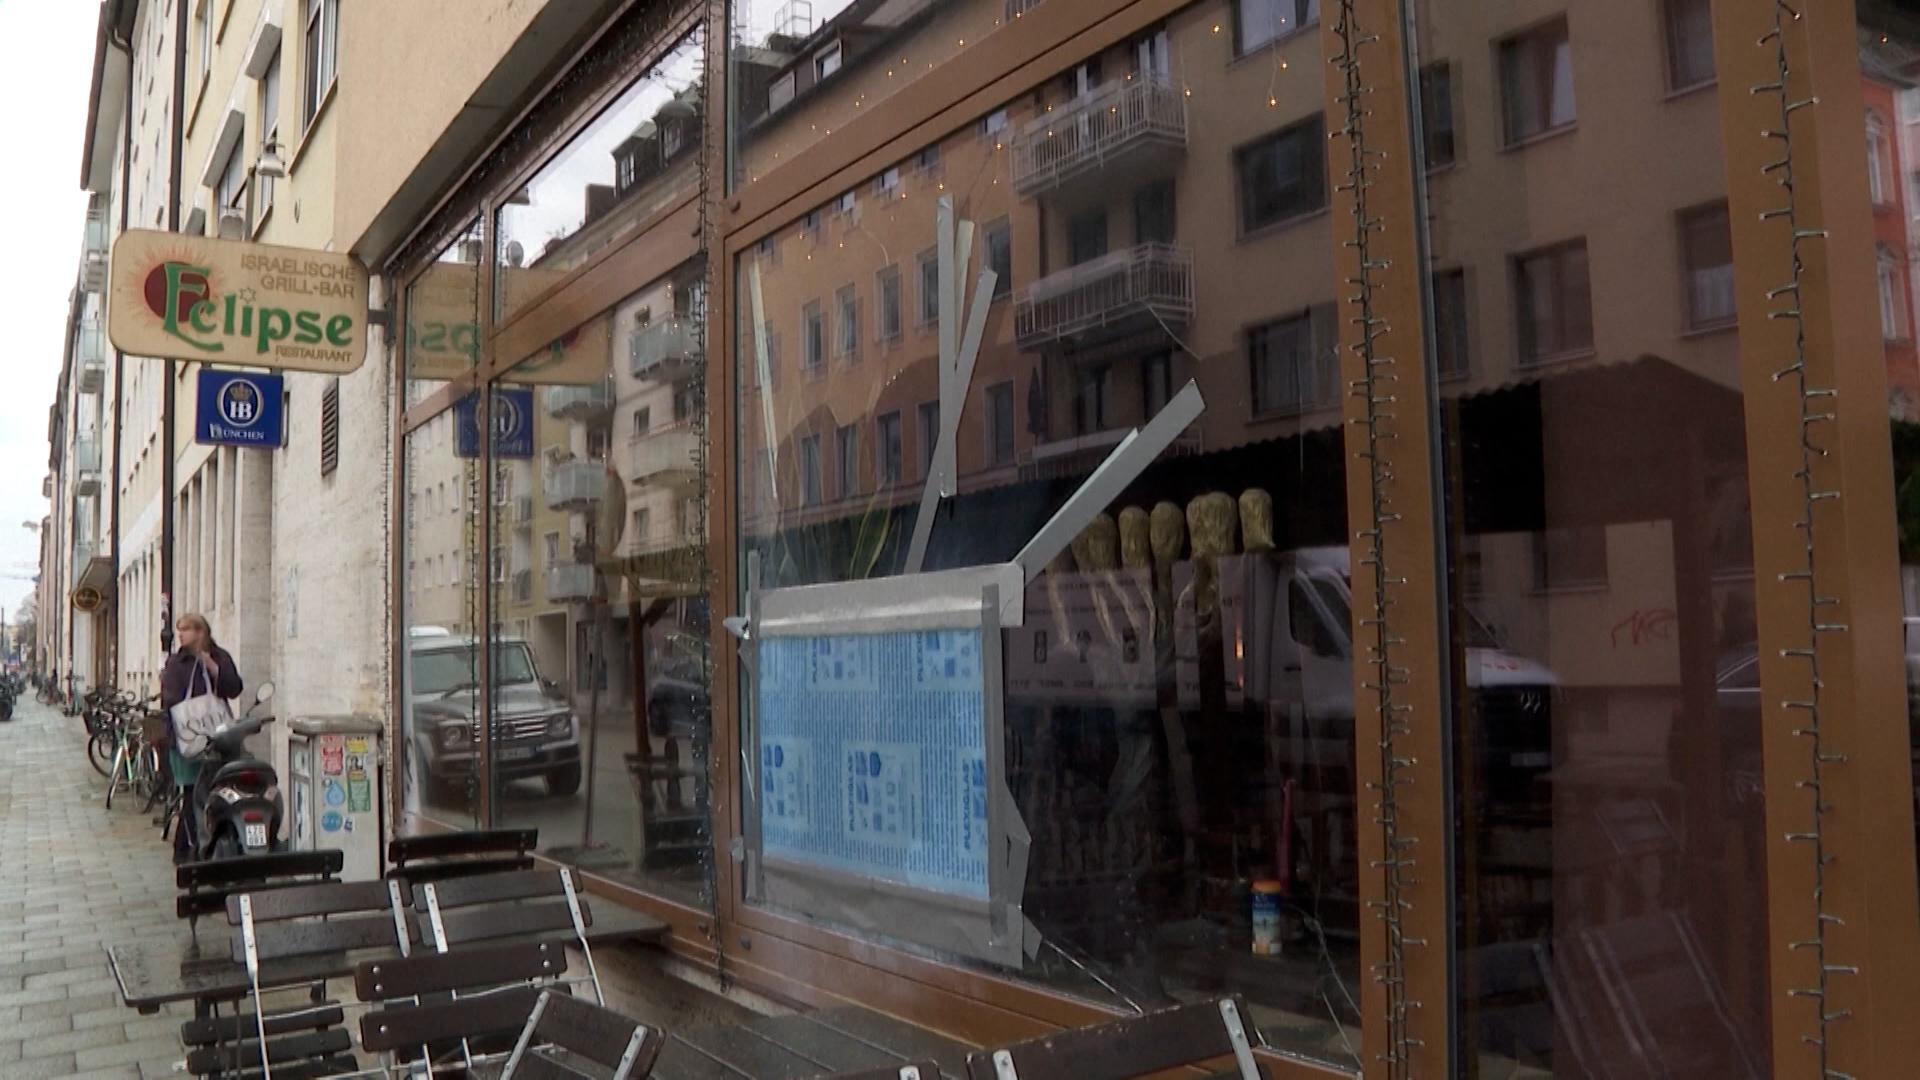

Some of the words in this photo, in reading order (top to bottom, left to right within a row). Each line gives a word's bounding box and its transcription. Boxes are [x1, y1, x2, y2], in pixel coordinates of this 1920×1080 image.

[241, 254, 356, 281] ISRAELISCHE
[163, 261, 353, 355] Eclipse
[275, 345, 352, 362] RESTAURANT
[230, 401, 253, 419] HB
